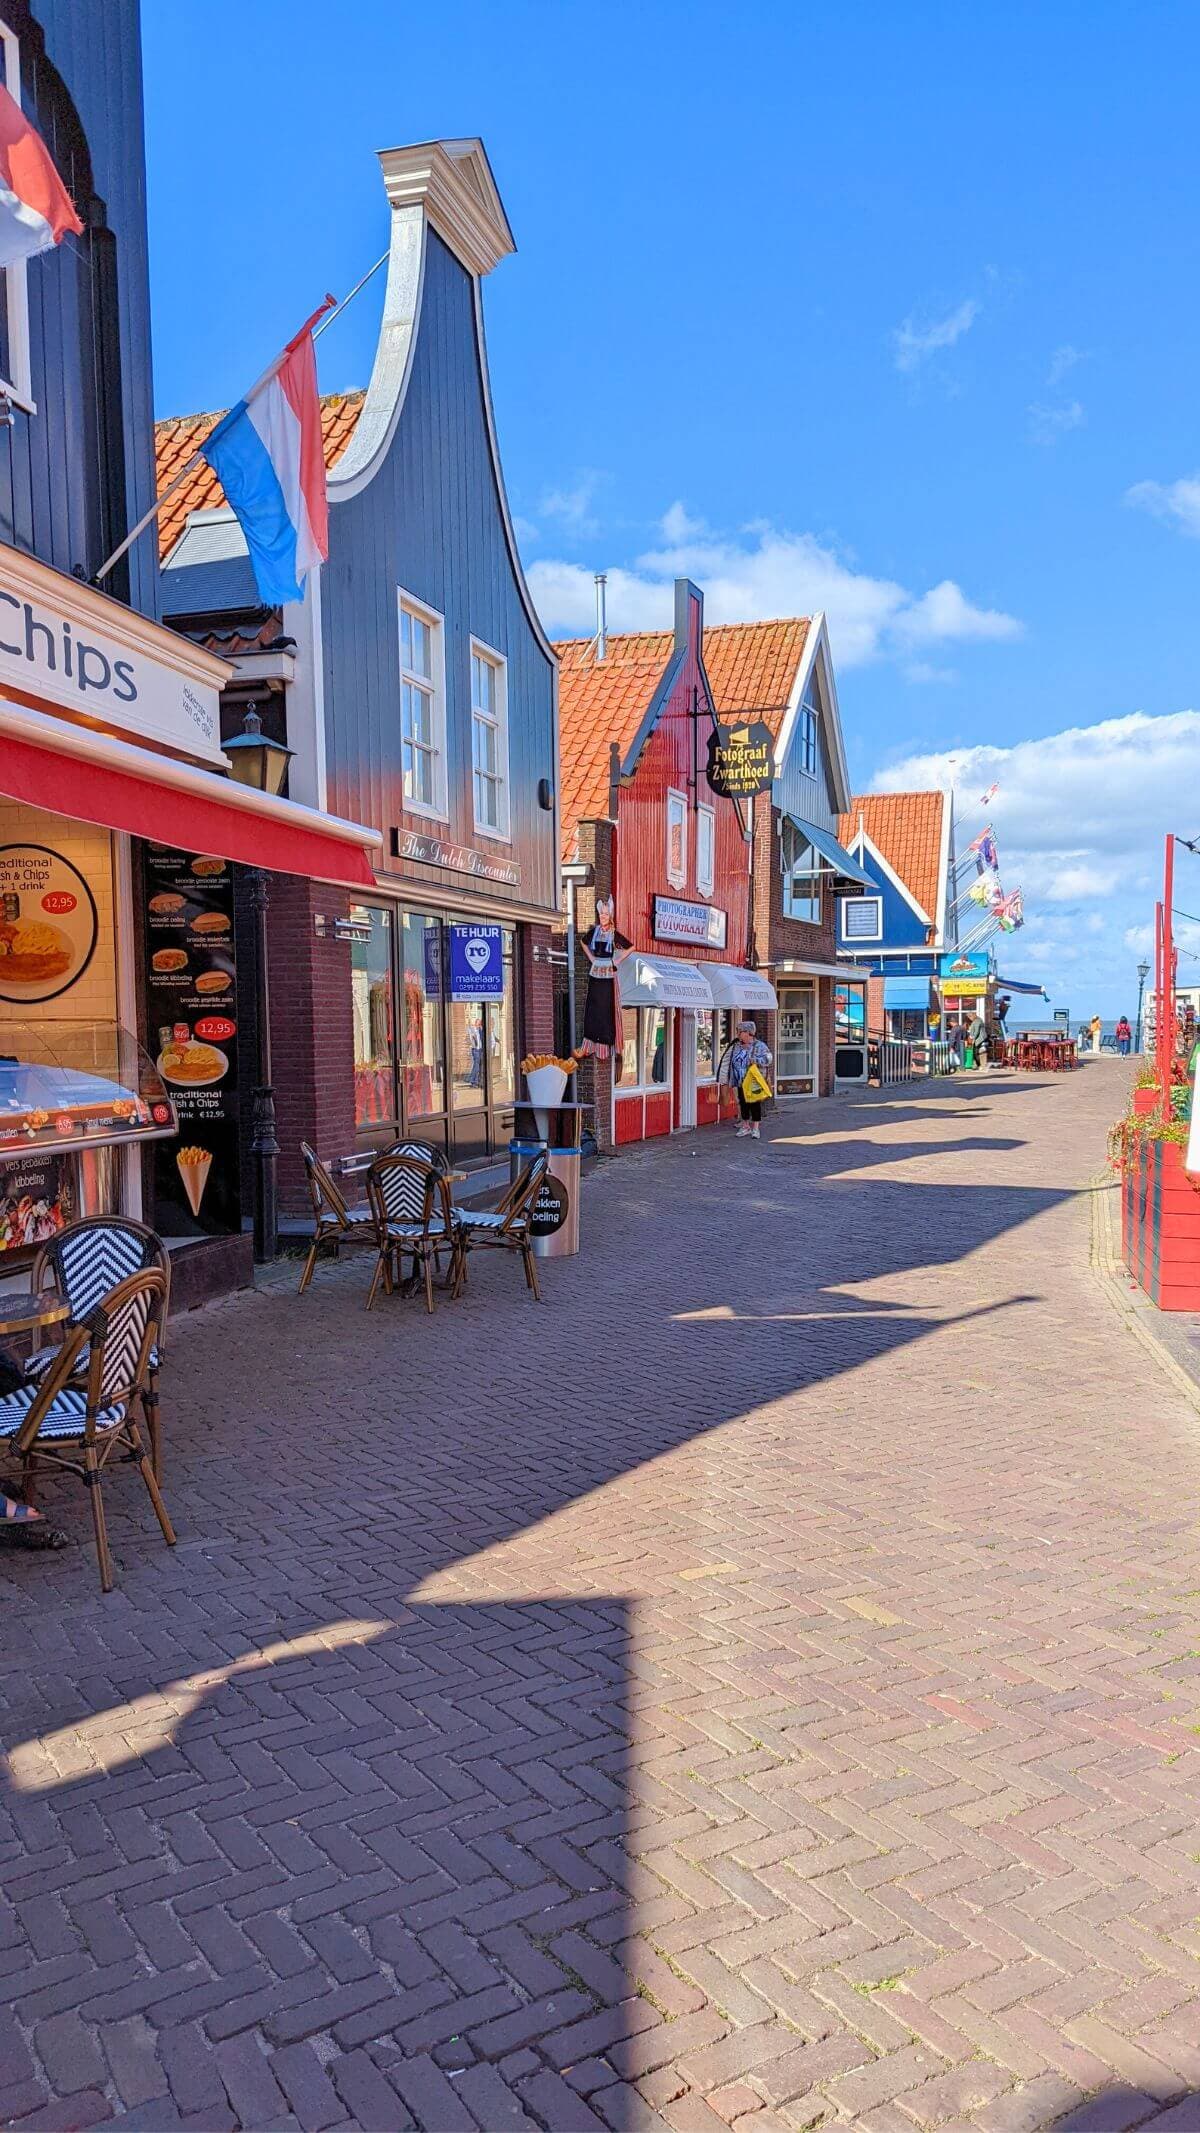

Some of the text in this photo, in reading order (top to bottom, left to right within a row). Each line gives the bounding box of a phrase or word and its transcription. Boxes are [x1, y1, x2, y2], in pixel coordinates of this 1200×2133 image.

[715, 743, 767, 764] Fotograaf
[712, 761, 769, 781] Zwarthoed
[0, 858, 53, 869] aditional
[402, 833, 518, 883] The Dutch Discounter
[0, 870, 11, 881] sh
[23, 869, 50, 880] Chips
[19, 882, 45, 891] drink
[45, 897, 74, 909] 12,95
[657, 900, 707, 920] PHOTOGRAPHER
[455, 927, 500, 938] TE HUUR
[657, 917, 705, 936] FOTOGRAAF
[455, 974, 501, 984] makelaars
[200, 1022, 231, 1035] 12,95
[169, 1090, 222, 1099] traditional
[196, 1098, 220, 1108] Chips
[178, 1111, 194, 1119] rink
[15, 1173, 45, 1188] kibbeling
[535, 1198, 561, 1209] akken
